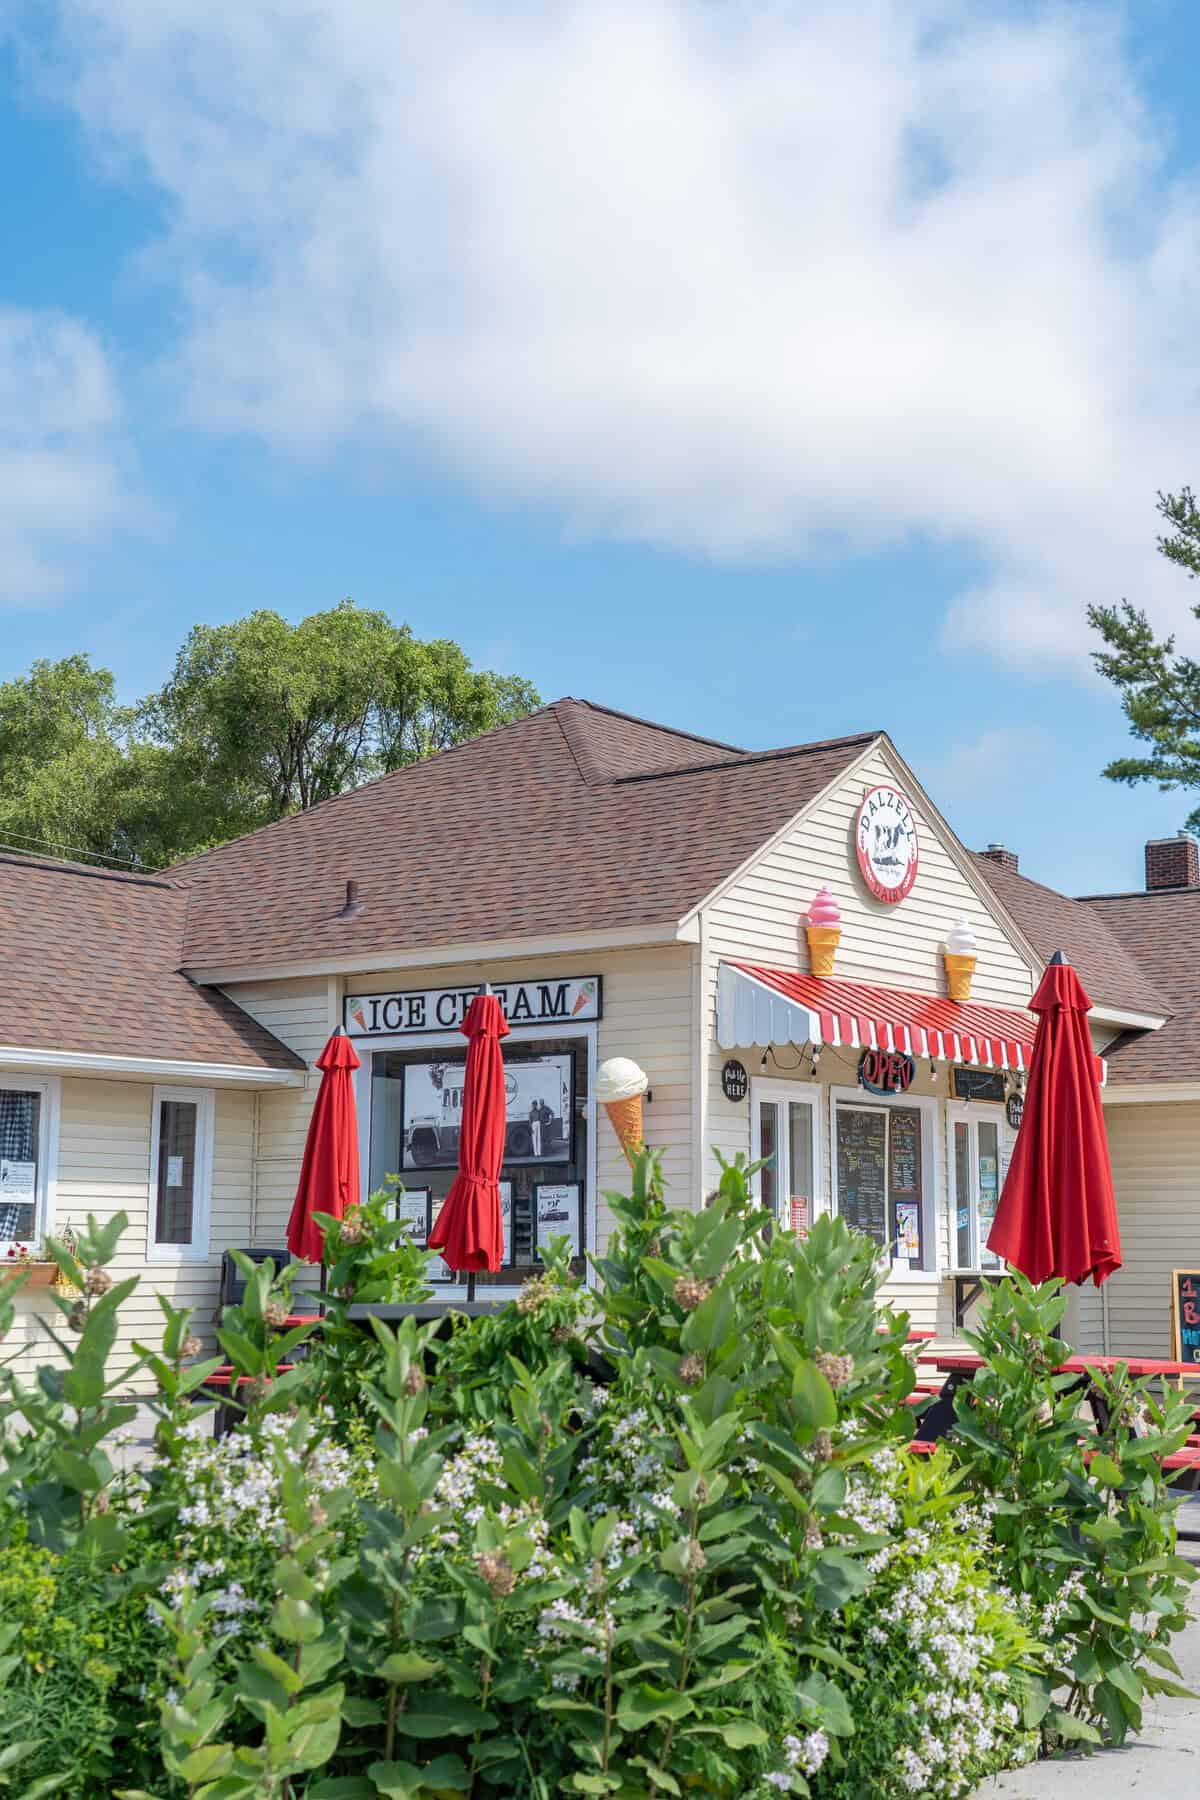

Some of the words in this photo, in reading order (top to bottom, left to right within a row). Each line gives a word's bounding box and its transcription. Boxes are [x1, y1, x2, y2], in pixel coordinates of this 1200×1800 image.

[861, 792, 914, 841] DALZELL
[368, 995, 426, 1031] ICE
[863, 1050, 911, 1089] OPEN
[727, 1083, 745, 1096] HERE
